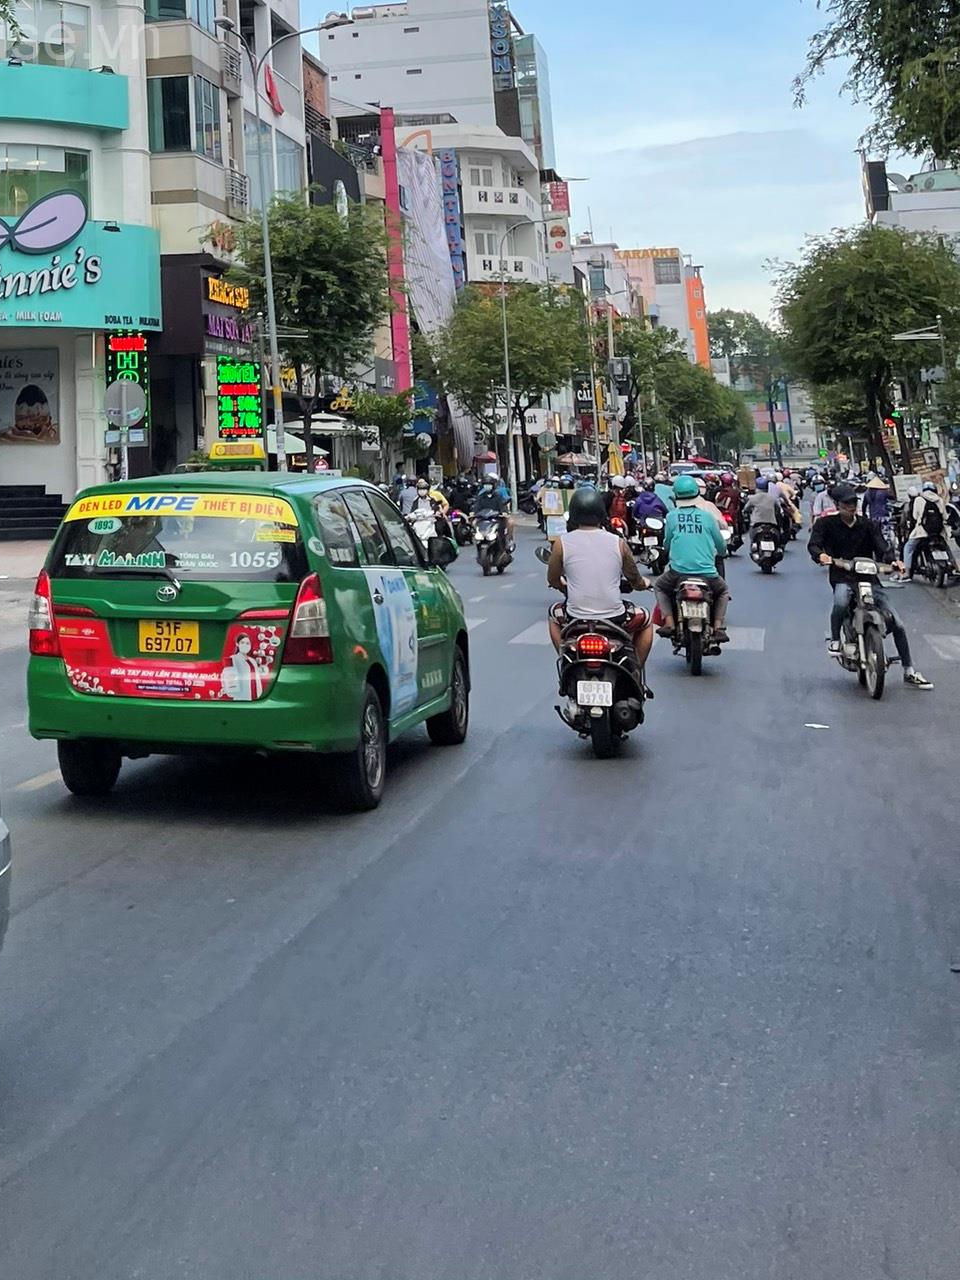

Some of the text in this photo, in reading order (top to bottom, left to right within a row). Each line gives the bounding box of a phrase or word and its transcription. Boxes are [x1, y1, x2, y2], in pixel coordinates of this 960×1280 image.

[615, 248, 679, 260] KARAOKE
[16, 311, 36, 321] MILK
[39, 311, 63, 322] FOAM
[219, 364, 258, 383] HOTEL
[102, 500, 123, 510] LED
[126, 496, 199, 511] MPE
[677, 513, 702, 524] BAE
[678, 524, 703, 535] MIN
[229, 551, 279, 568] 1055
[155, 621, 181, 636] 51F
[145, 638, 193, 652] 697.07
